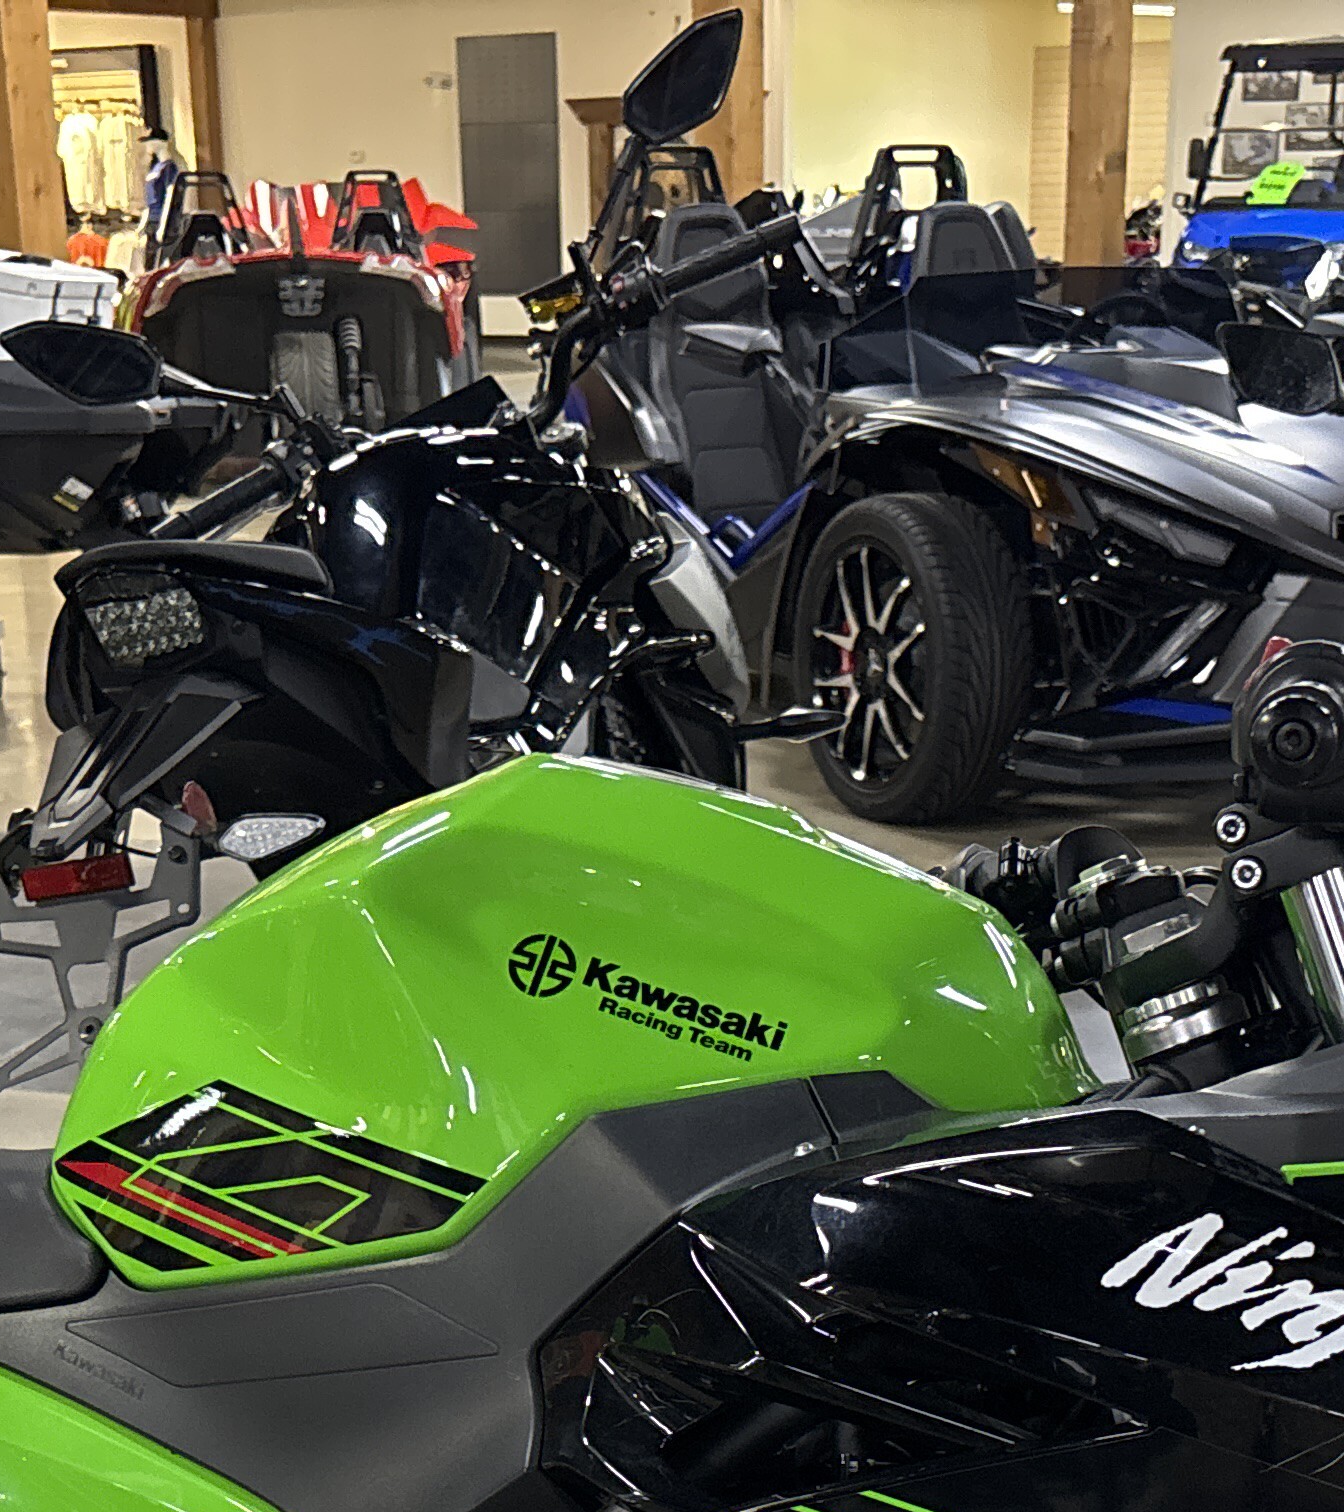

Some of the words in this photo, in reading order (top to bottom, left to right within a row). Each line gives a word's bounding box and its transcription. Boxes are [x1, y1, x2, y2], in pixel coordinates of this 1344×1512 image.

[582, 956, 790, 1052] Kawasaki
[597, 995, 683, 1041] Racing
[688, 1025, 754, 1063] Team
